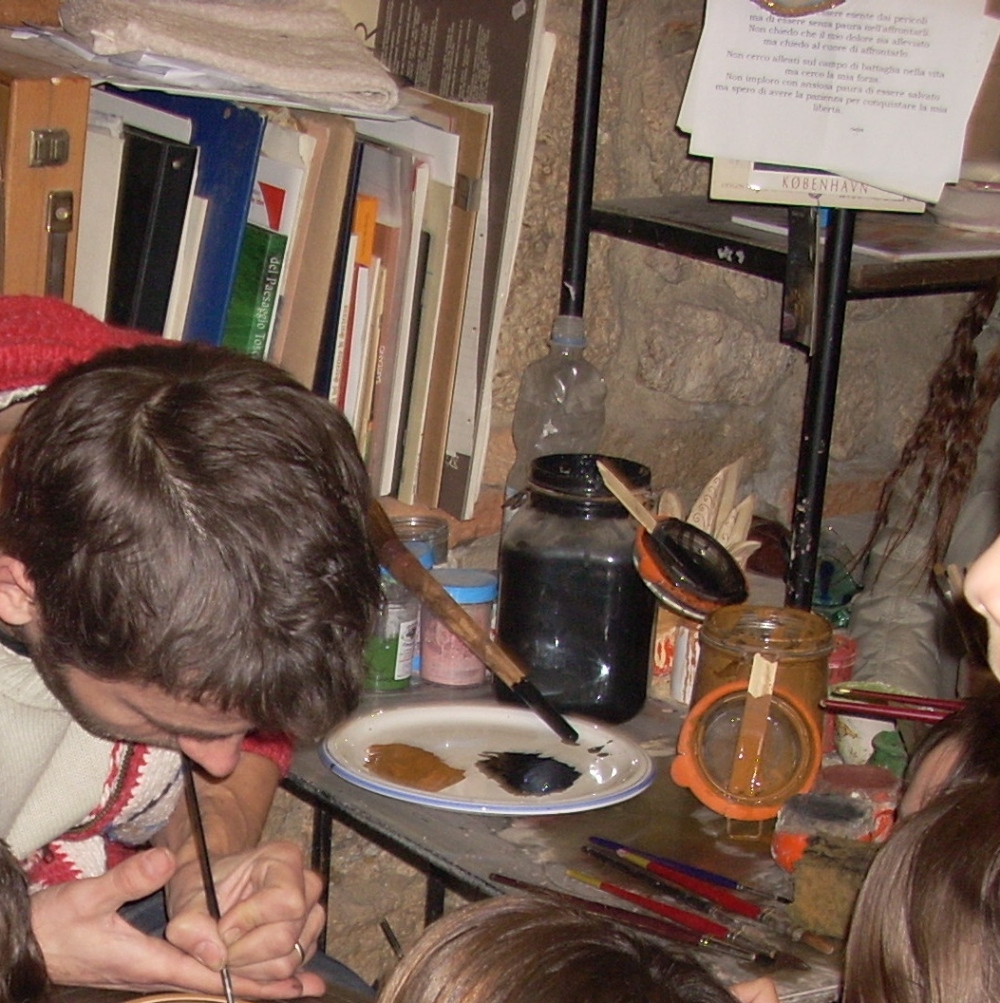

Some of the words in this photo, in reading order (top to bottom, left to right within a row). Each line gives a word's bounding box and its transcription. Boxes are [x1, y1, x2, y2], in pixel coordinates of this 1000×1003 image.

[766, 15, 774, 23] di
[748, 24, 766, 33] Non
[768, 26, 799, 36] chiedo
[800, 28, 817, 37] che
[780, 39, 809, 49] chiedo
[811, 41, 820, 49] al
[849, 45, 858, 53] di
[726, 50, 744, 60] Non
[850, 62, 859, 71] di
[903, 68, 925, 77] nella
[726, 72, 743, 82] Non
[745, 74, 780, 86] imploro
[865, 86, 874, 95] di
[827, 71, 834, 79] la
[758, 87, 767, 95] di
[795, 90, 803, 99] la
[845, 96, 860, 105] per
[919, 103, 927, 112] la
[781, 175, 869, 194] KØBENHAVN
[267, 256, 281, 275] del
[254, 277, 278, 331] Paesaggio
